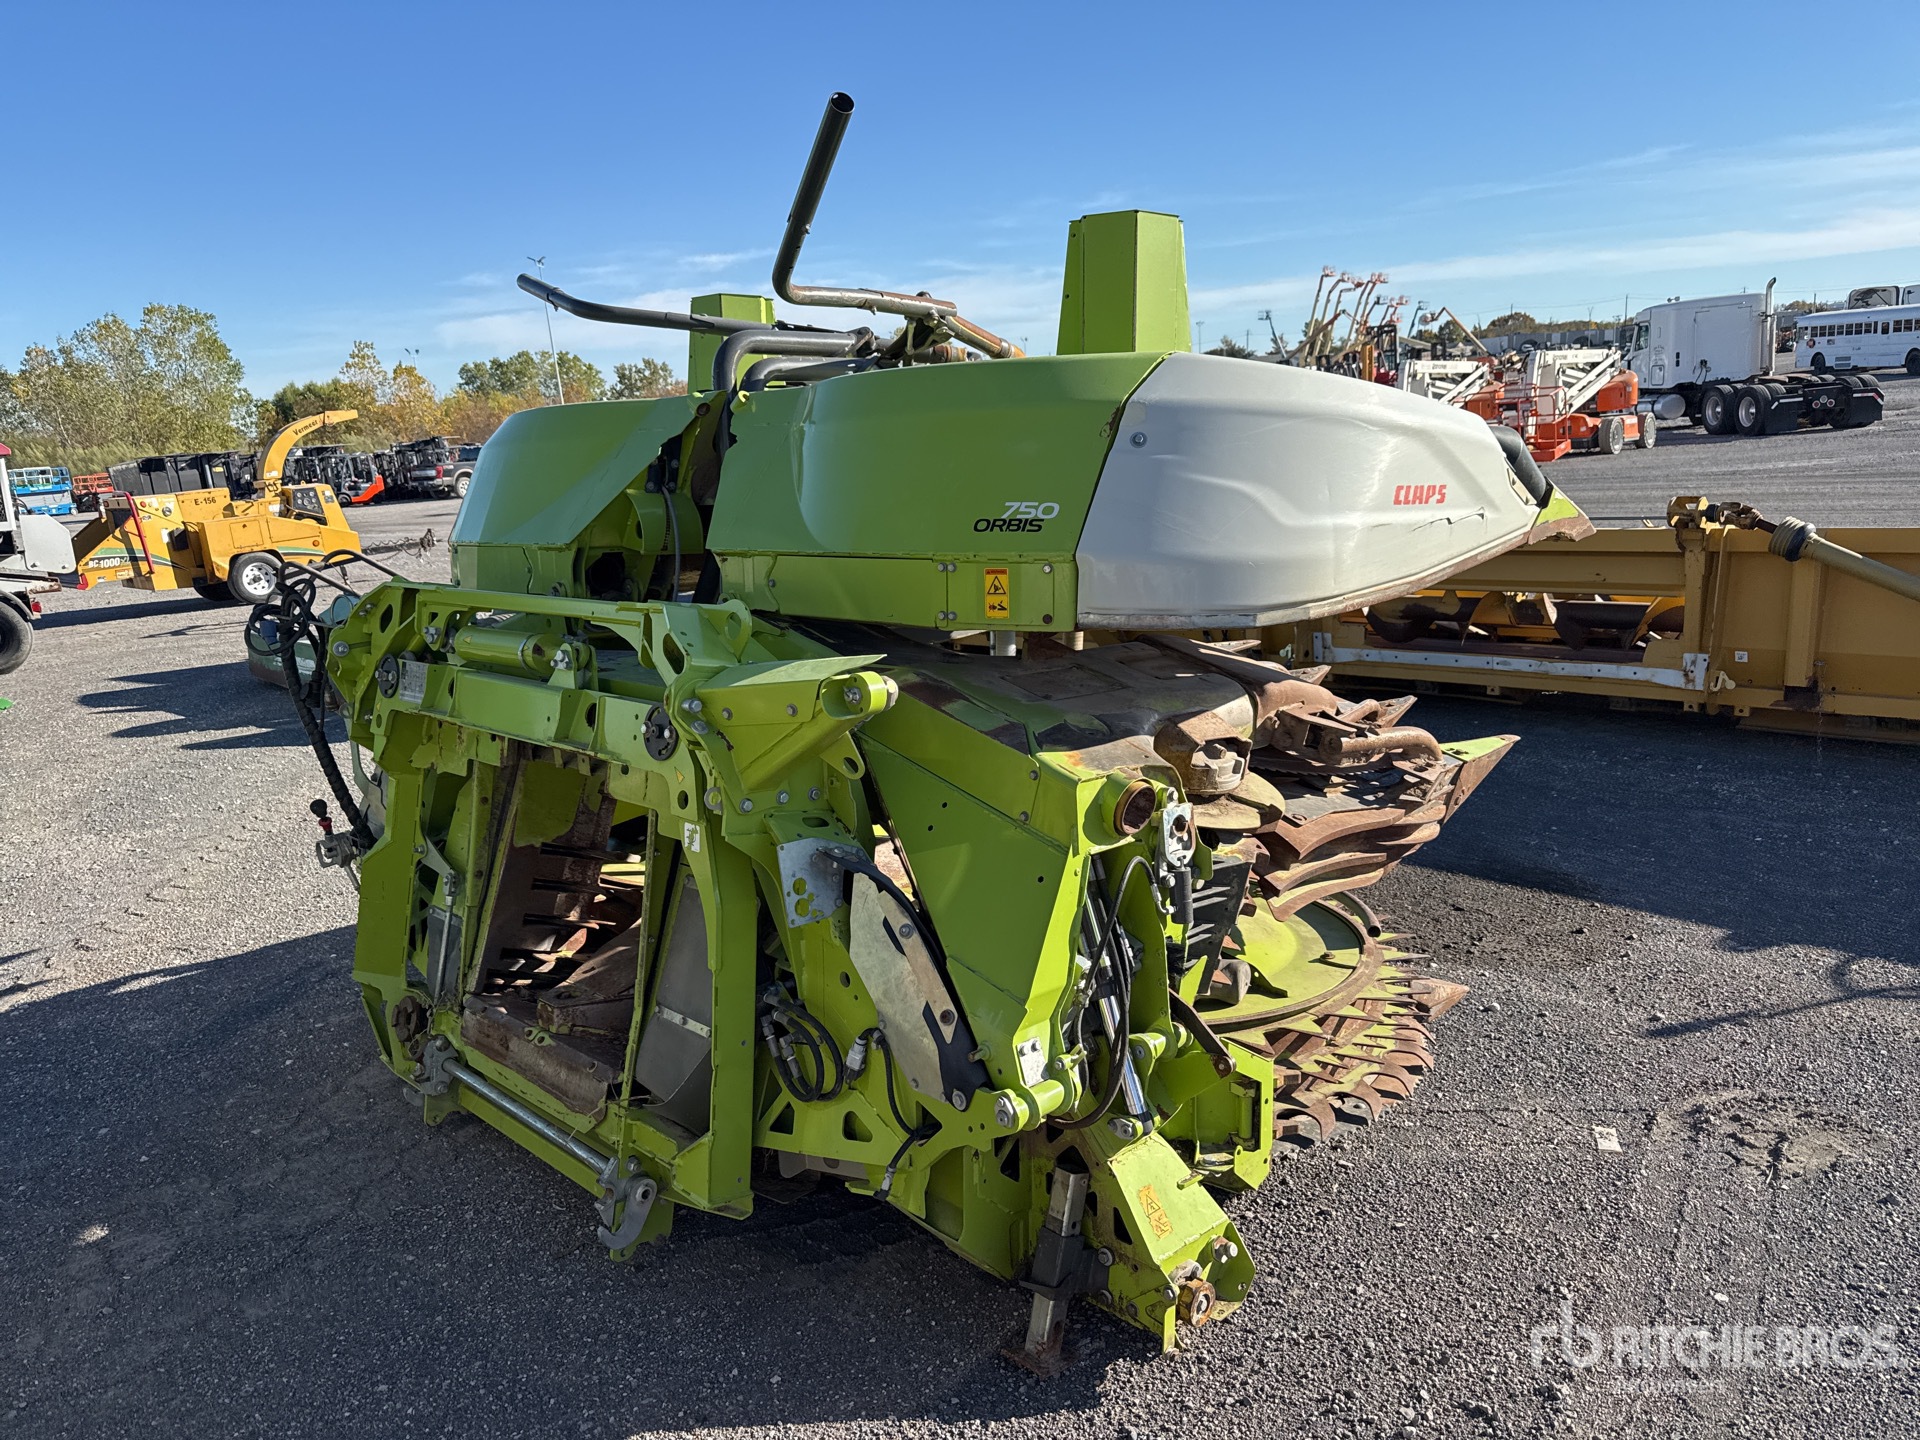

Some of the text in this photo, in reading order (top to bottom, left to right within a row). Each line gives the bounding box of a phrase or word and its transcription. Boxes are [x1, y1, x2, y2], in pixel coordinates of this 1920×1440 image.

[293, 420, 319, 436] Vermeer
[194, 497, 217, 506] E-156
[1001, 501, 1060, 519] 750
[973, 518, 1045, 533] ORBIS
